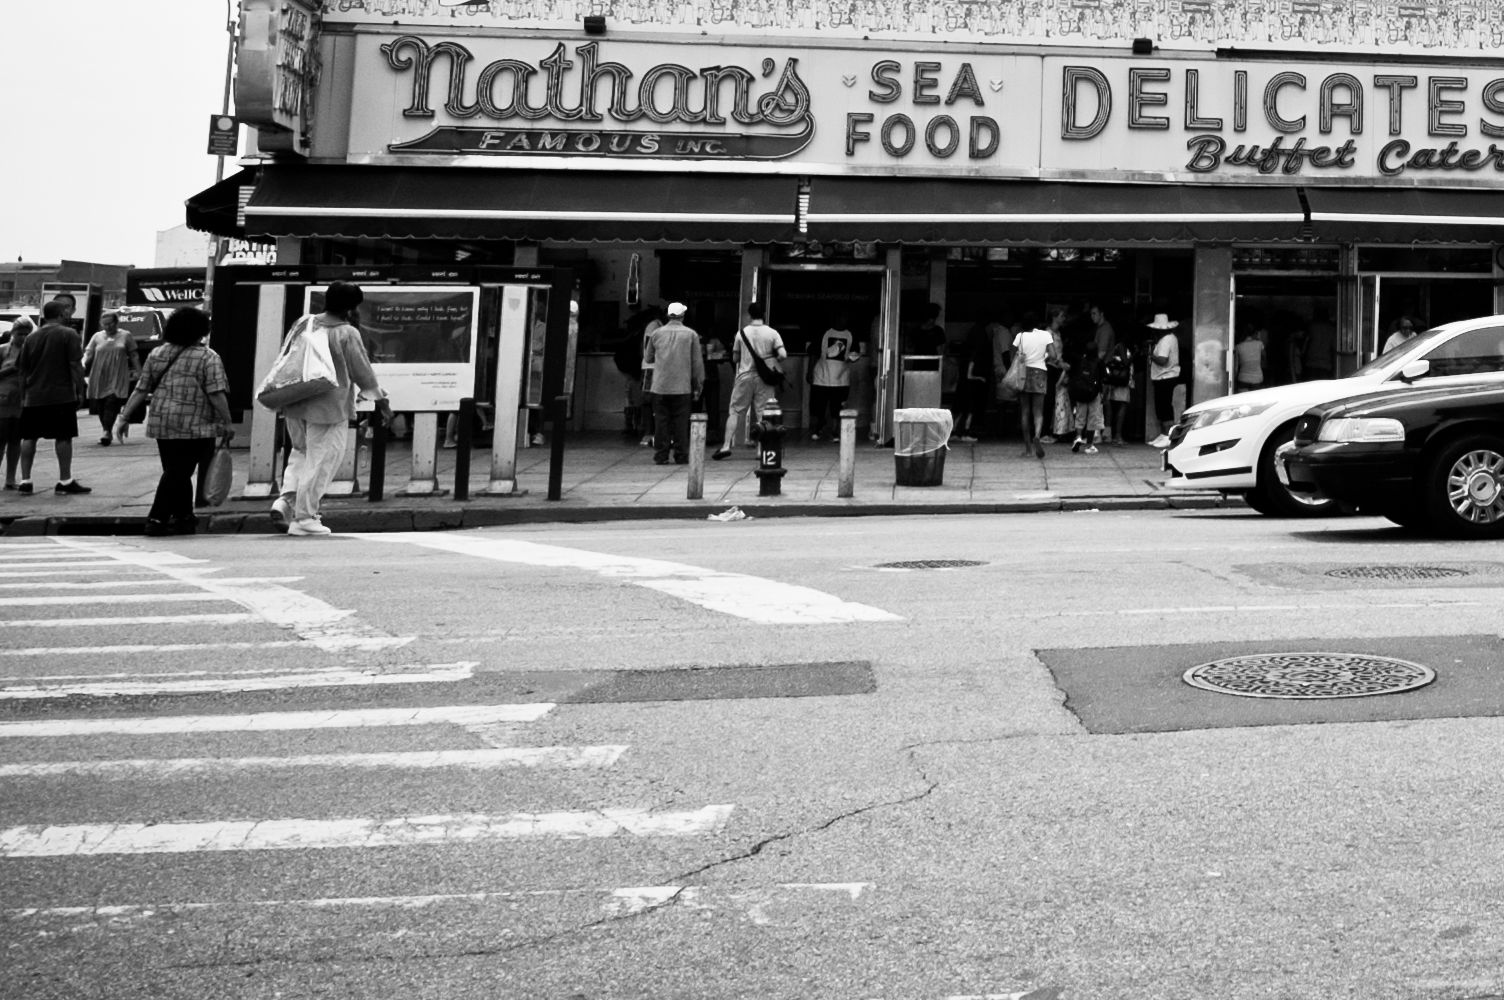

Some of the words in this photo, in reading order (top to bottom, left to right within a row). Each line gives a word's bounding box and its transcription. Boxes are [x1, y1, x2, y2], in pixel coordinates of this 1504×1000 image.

[868, 59, 985, 106] SEA
[478, 129, 663, 154] FAMOUS
[845, 112, 1000, 159] FOOD
[1185, 134, 1357, 175] Buffet
[761, 450, 777, 466] 12
